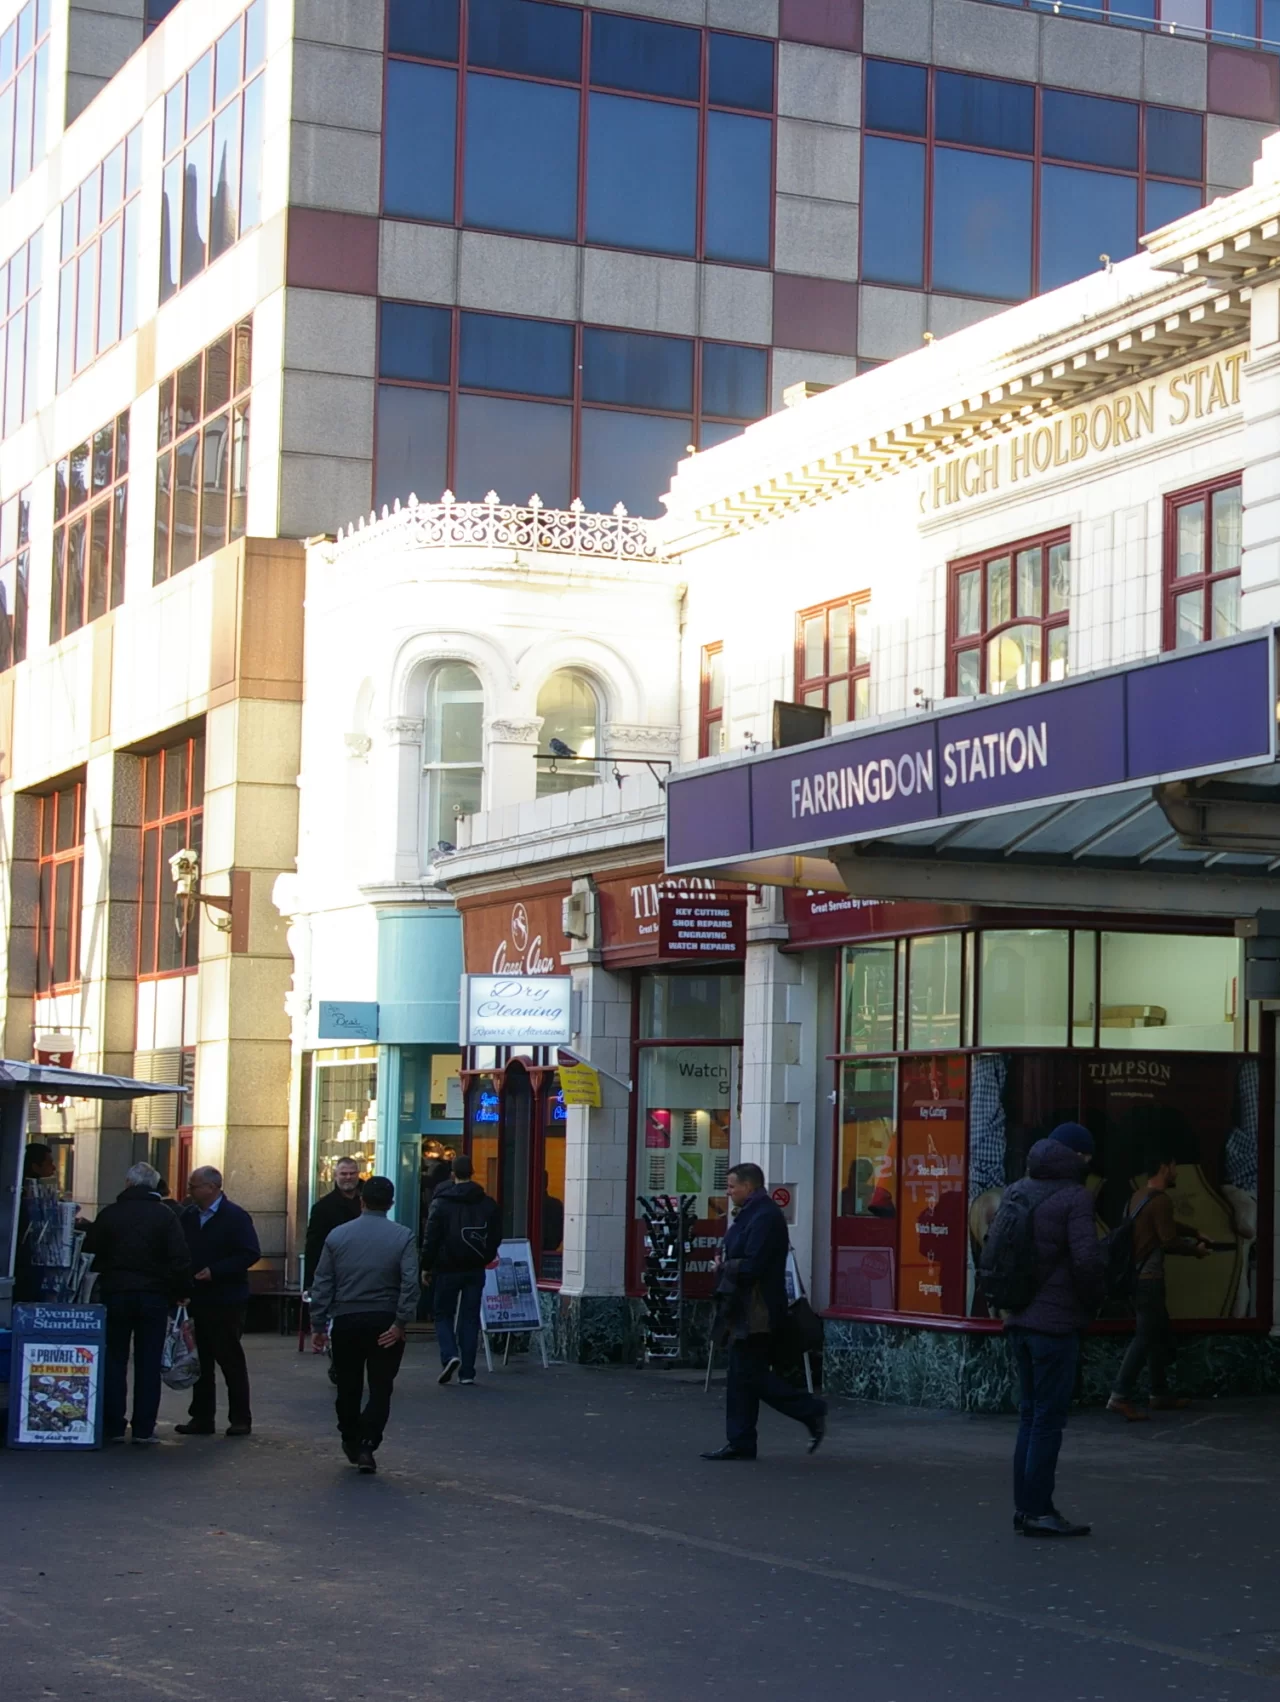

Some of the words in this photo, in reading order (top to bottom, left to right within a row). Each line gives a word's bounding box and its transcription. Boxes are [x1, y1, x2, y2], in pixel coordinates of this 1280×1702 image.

[932, 443, 1000, 509] HIGH
[1010, 385, 1156, 482] HOLBORN
[791, 749, 934, 818] FARRINGDON
[943, 721, 1048, 787] STATION
[675, 908, 693, 917] KEY
[694, 908, 730, 917] CUTTING
[672, 920, 695, 928] SHOE
[697, 920, 733, 928] REPAIRS
[678, 931, 727, 939] ENGRAVING
[668, 943, 698, 951] WATCH
[700, 943, 736, 951] REPAIRS
[490, 981, 550, 1001] Dry
[477, 1001, 563, 1021] Cleaning
[679, 1063, 729, 1078] Watch
[1088, 1060, 1171, 1080] TIMPSON
[920, 1107, 929, 1118] Key
[929, 1107, 947, 1120] Cutting
[35, 1307, 95, 1320] Evening
[497, 1311, 509, 1320] 20
[33, 1319, 102, 1330] Standard
[37, 1348, 75, 1363] PRIVATE
